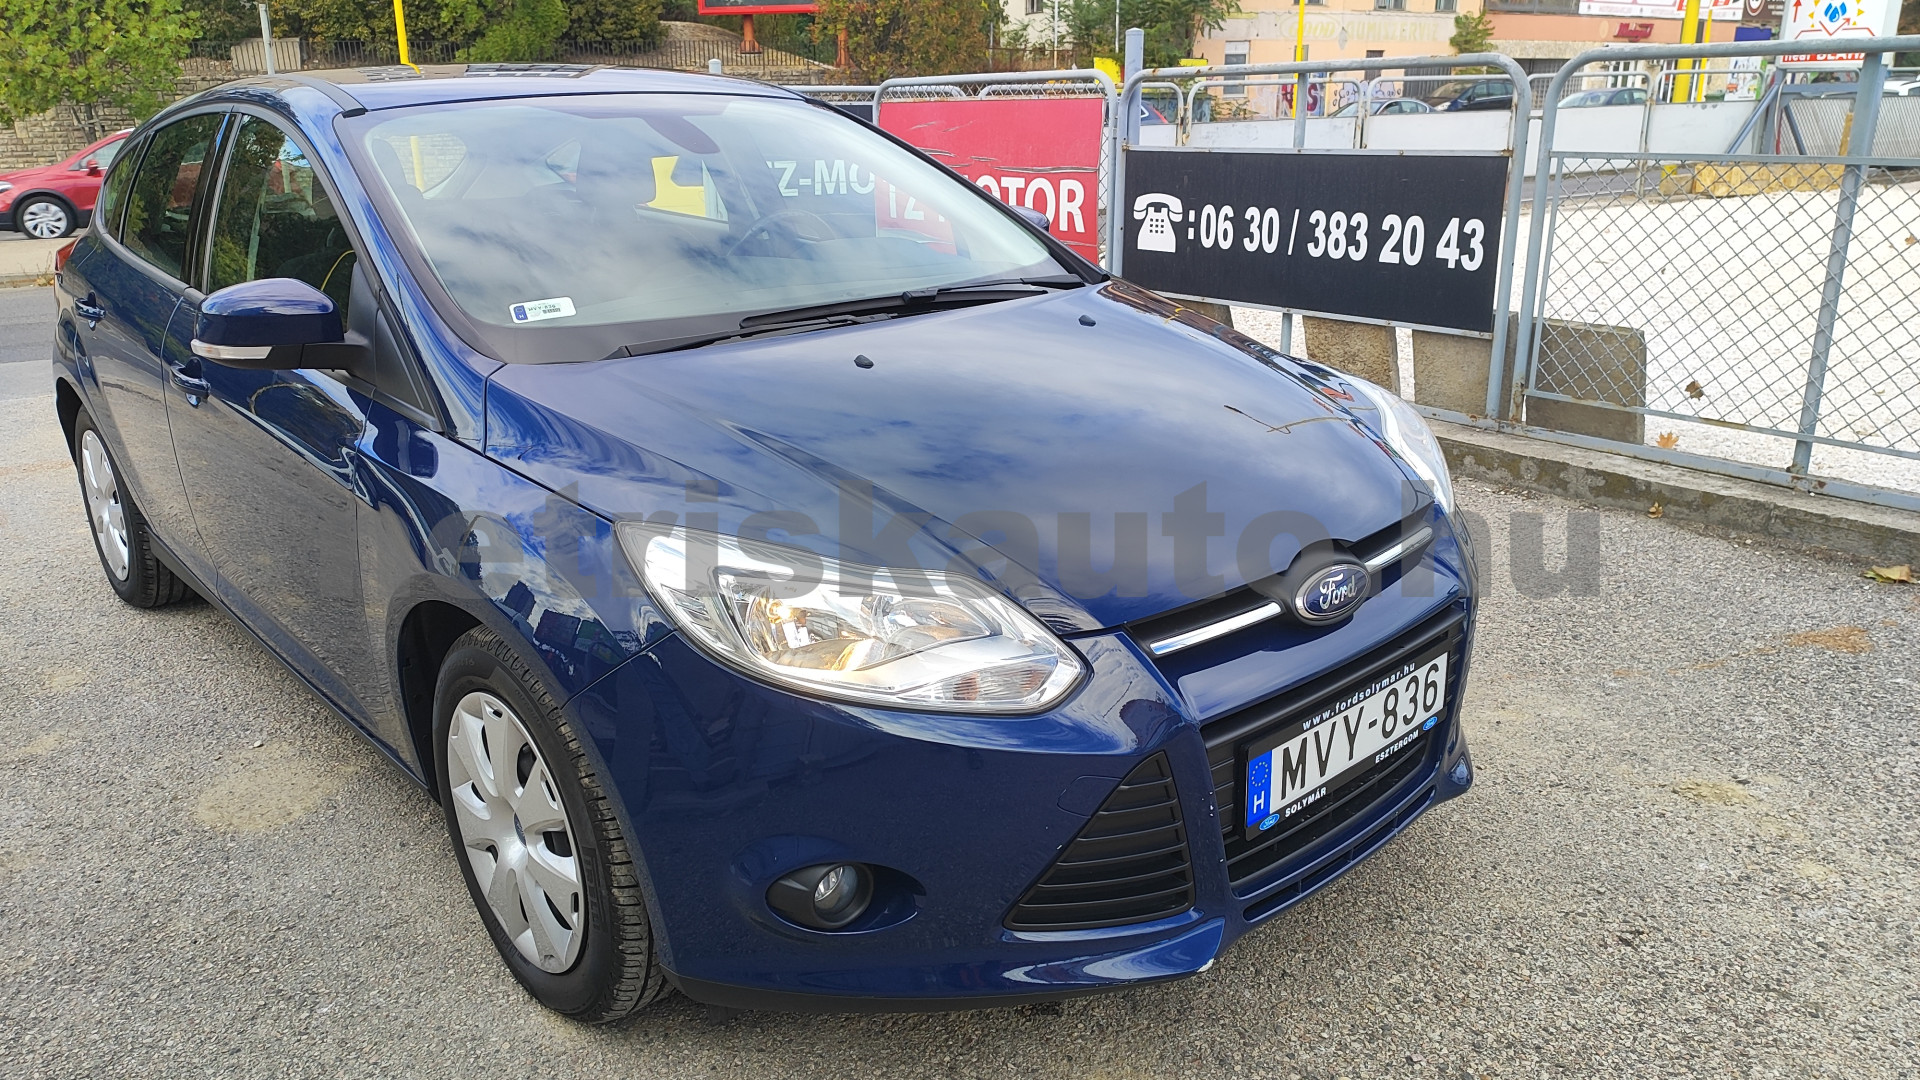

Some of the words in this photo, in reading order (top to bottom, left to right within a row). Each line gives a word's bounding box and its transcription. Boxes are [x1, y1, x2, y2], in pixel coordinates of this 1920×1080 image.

[1243, 206, 1280, 254] 30
[1307, 210, 1368, 262] 383
[1378, 213, 1425, 266] 20
[1436, 217, 1485, 272] 43
[1319, 573, 1357, 609] Ford
[1302, 662, 1416, 731] www.fordsolymar.hu
[1281, 663, 1439, 800] MVY-836
[1253, 790, 1265, 814] H
[1284, 787, 1327, 818] SOLYMÁR
[1375, 729, 1419, 764] ESZTERGOM
